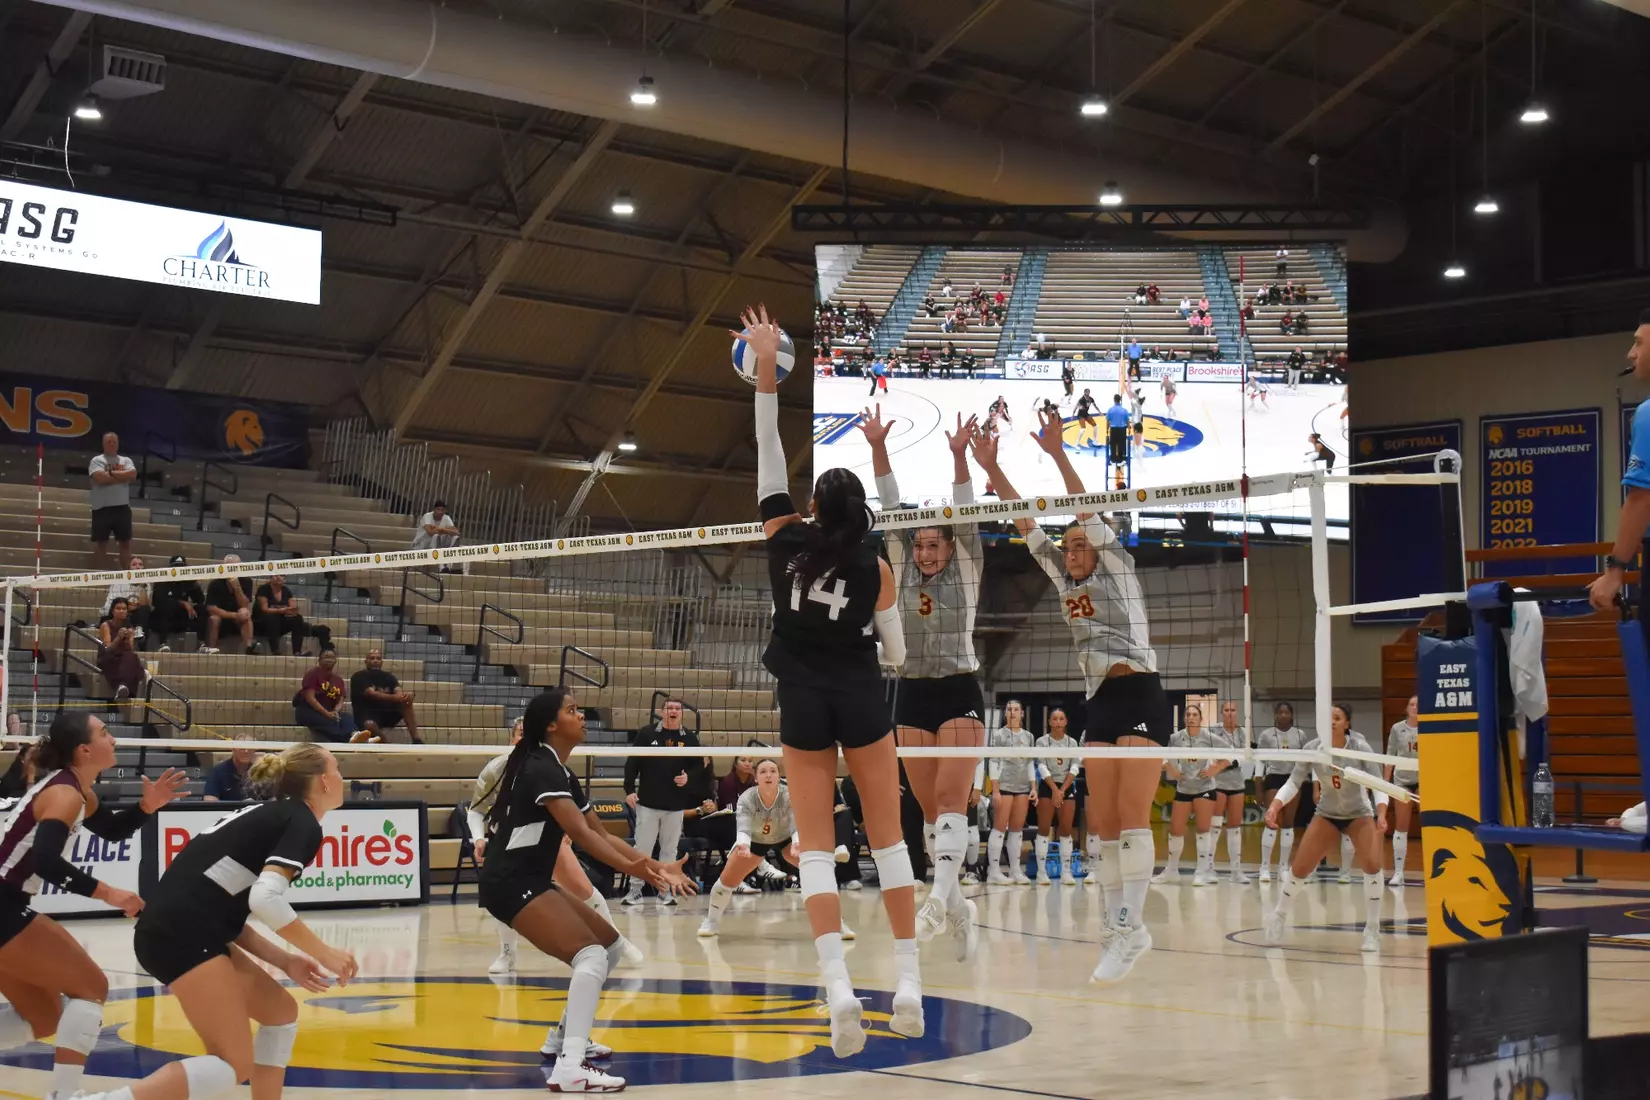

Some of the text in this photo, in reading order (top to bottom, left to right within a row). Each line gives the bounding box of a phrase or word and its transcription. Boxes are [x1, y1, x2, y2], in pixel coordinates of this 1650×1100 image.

[16, 241, 73, 255] SYSTEMS
[163, 257, 271, 289] CHARTER
[1517, 424, 1586, 439] SOFTBALL
[1383, 435, 1447, 450] SOFTBALL
[1488, 444, 1592, 460] NCAA TOURNAMENT
[1491, 460, 1534, 477] 2016
[1154, 482, 1236, 500] EAST TEXAS A&M
[1491, 479, 1533, 496] 2018
[1054, 492, 1130, 508] EAST TEXAS A&M
[1491, 499, 1534, 515] 2019
[893, 510, 918, 523] TEXAS
[920, 509, 937, 520] A&M
[960, 500, 1030, 517] EAST TEXAS A&M
[711, 524, 764, 537] EAST TEXAS A&
[1491, 518, 1533, 534] 2021
[569, 540, 584, 548] EAST
[586, 538, 606, 547] TEXAS
[638, 534, 654, 543] EAST
[656, 532, 676, 542] TEXAS
[442, 550, 456, 558] EAST
[458, 548, 476, 558] TEXAS
[504, 544, 518, 552] EAST
[520, 542, 539, 552] TEXAS
[790, 567, 850, 621] 14
[918, 592, 932, 616] 3
[1066, 594, 1095, 619] 20
[1439, 664, 1467, 674] EAST
[1436, 678, 1470, 688] TEXAS
[1434, 691, 1473, 708] A&M
[1332, 775, 1341, 790] 6
[593, 804, 623, 813] LIONS
[762, 824, 771, 835] 9
[71, 834, 133, 864] LACE
[326, 877, 335, 887] &
[335, 870, 414, 891] pharmacy
